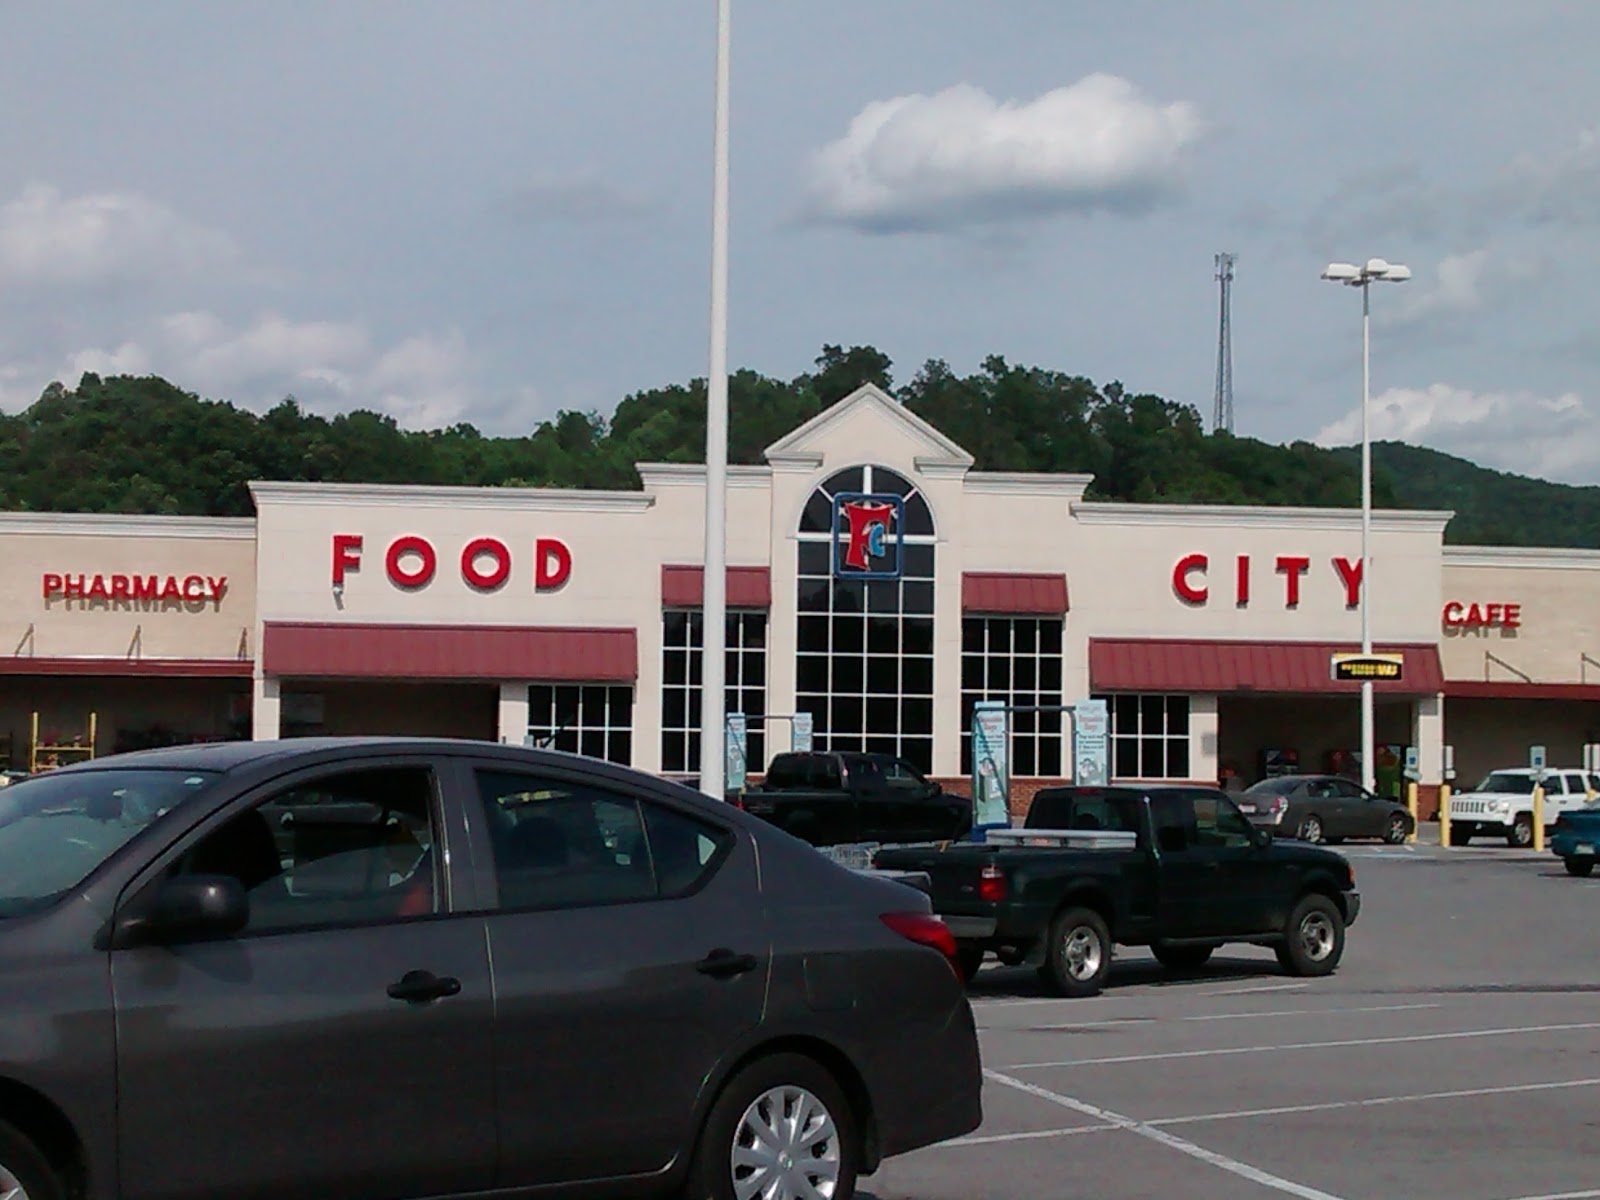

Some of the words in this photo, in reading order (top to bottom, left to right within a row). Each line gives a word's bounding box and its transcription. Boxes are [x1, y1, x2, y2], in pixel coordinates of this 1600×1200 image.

[333, 535, 572, 590] FOOD
[1173, 554, 1373, 607] CITY
[43, 574, 227, 604] PHARMACY
[1443, 602, 1521, 628] CAFE
